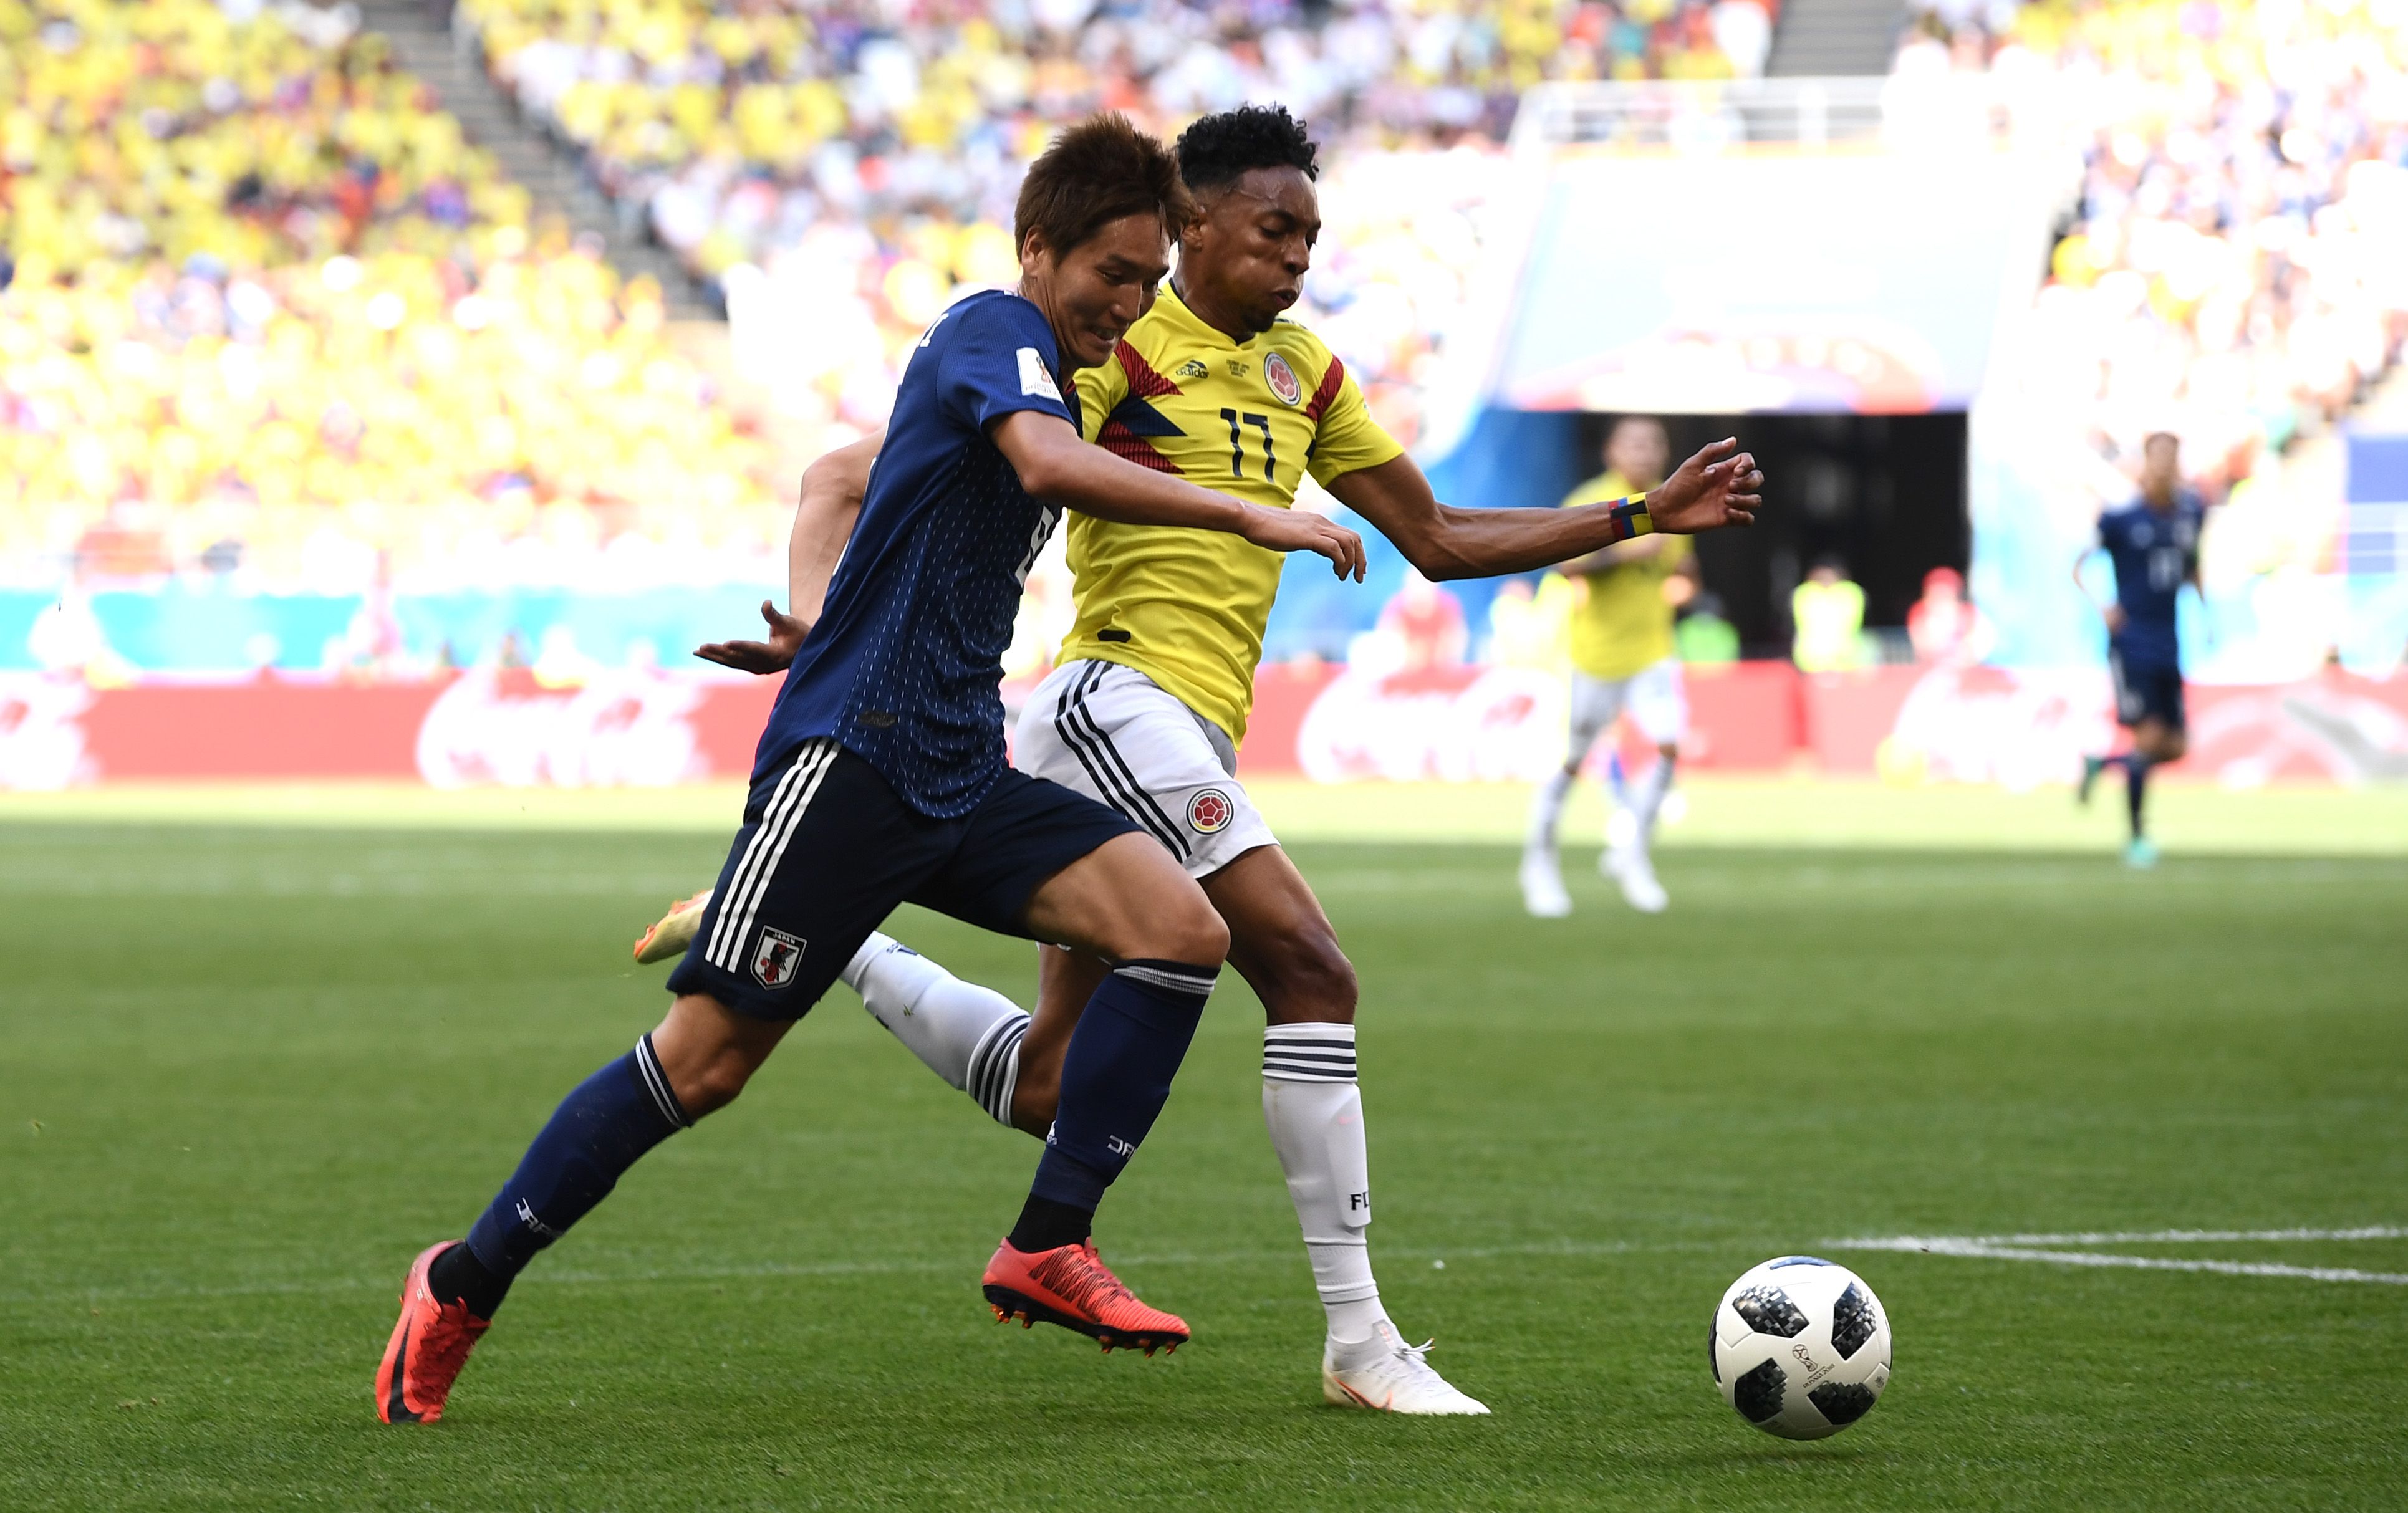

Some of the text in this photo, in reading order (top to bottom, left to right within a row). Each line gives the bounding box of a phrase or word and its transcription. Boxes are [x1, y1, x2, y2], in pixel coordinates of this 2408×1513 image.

[1175, 367, 1210, 380] adidas
[1220, 407, 1277, 484] 17
[773, 931, 796, 946] JAPAN
[1803, 1372, 1824, 1389] RUSSIA
